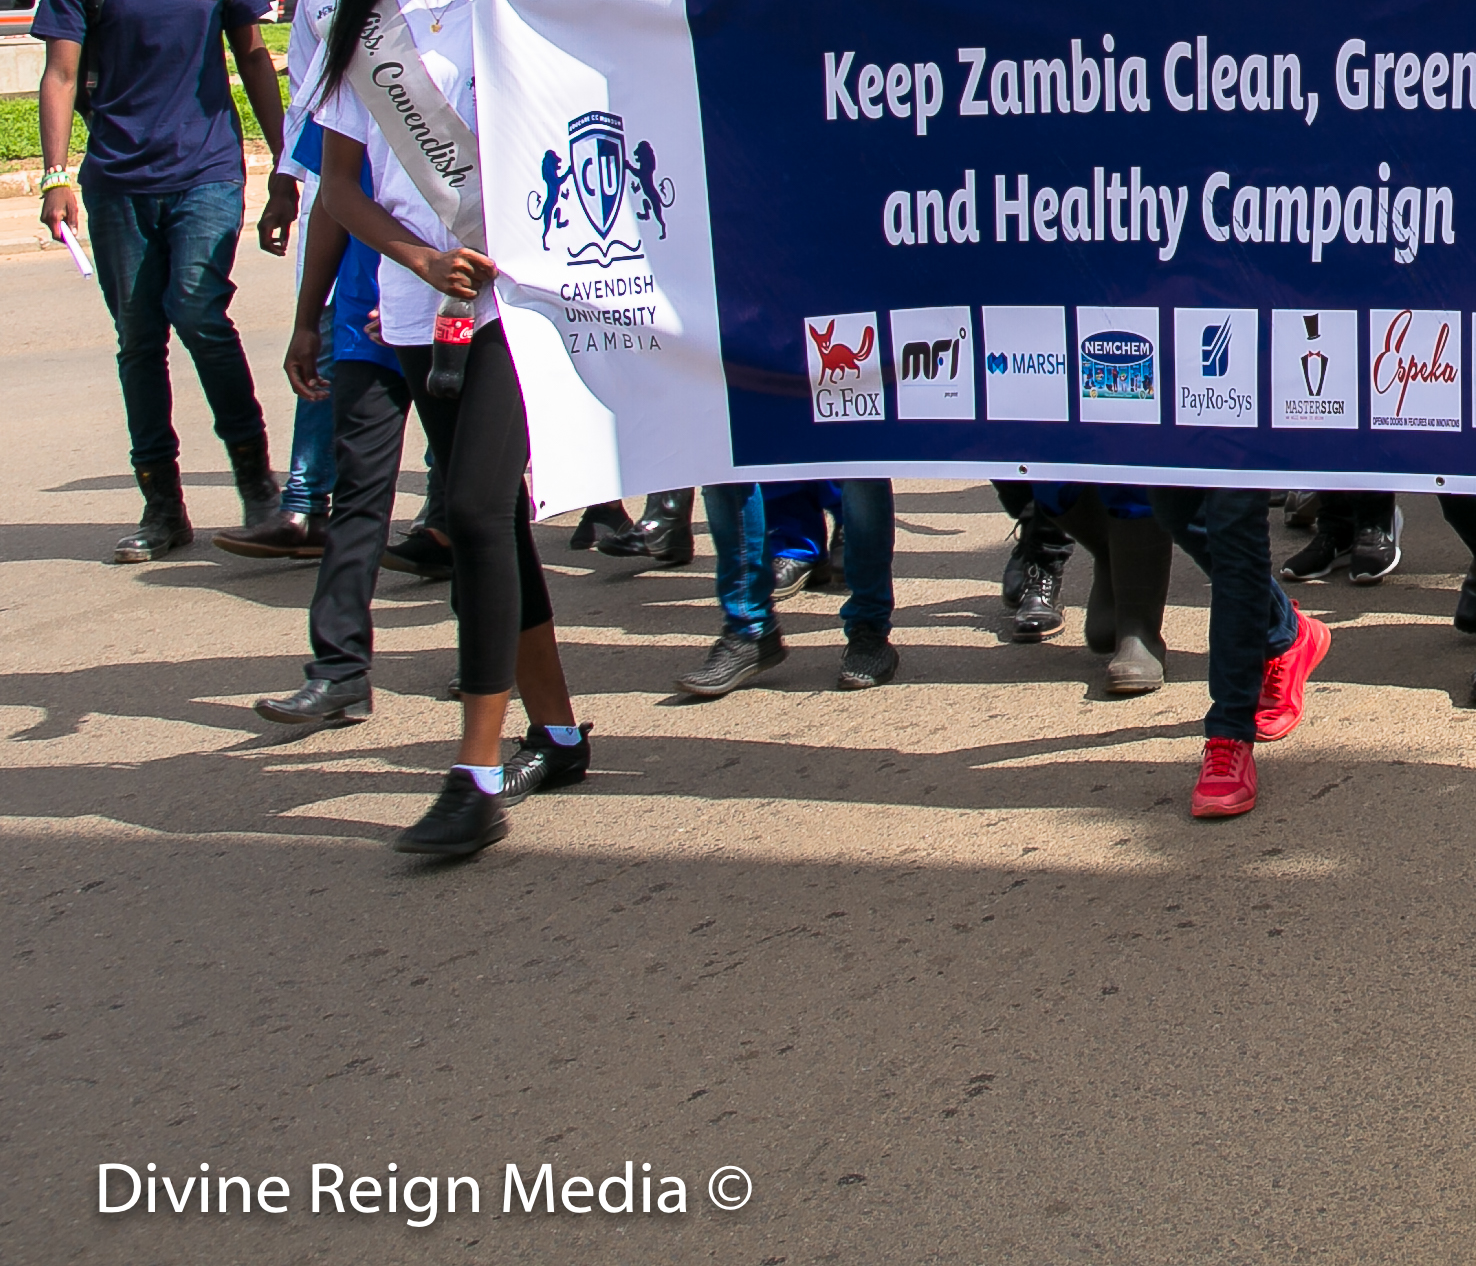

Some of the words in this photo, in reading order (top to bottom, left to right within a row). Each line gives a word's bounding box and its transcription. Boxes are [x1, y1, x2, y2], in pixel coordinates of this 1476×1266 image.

[823, 50, 944, 136] Keep
[957, 33, 1151, 116] Zambia
[1163, 35, 1319, 126] Clean,
[371, 61, 474, 189] Cavendish
[581, 155, 618, 197] CU
[883, 169, 980, 246] and
[994, 166, 1189, 262] Healthy
[1202, 161, 1456, 264] Campaign
[560, 275, 655, 302] CAVENDISH
[565, 306, 656, 326] UNIVERSITY
[568, 331, 662, 354] ZAMBIA
[1084, 340, 1151, 356] NEMCHEM
[1012, 352, 1067, 376] MARSH
[1373, 309, 1459, 417] Espeka
[1180, 386, 1253, 418] PayRo-Sys
[1285, 400, 1345, 415] MASTERSIGN
